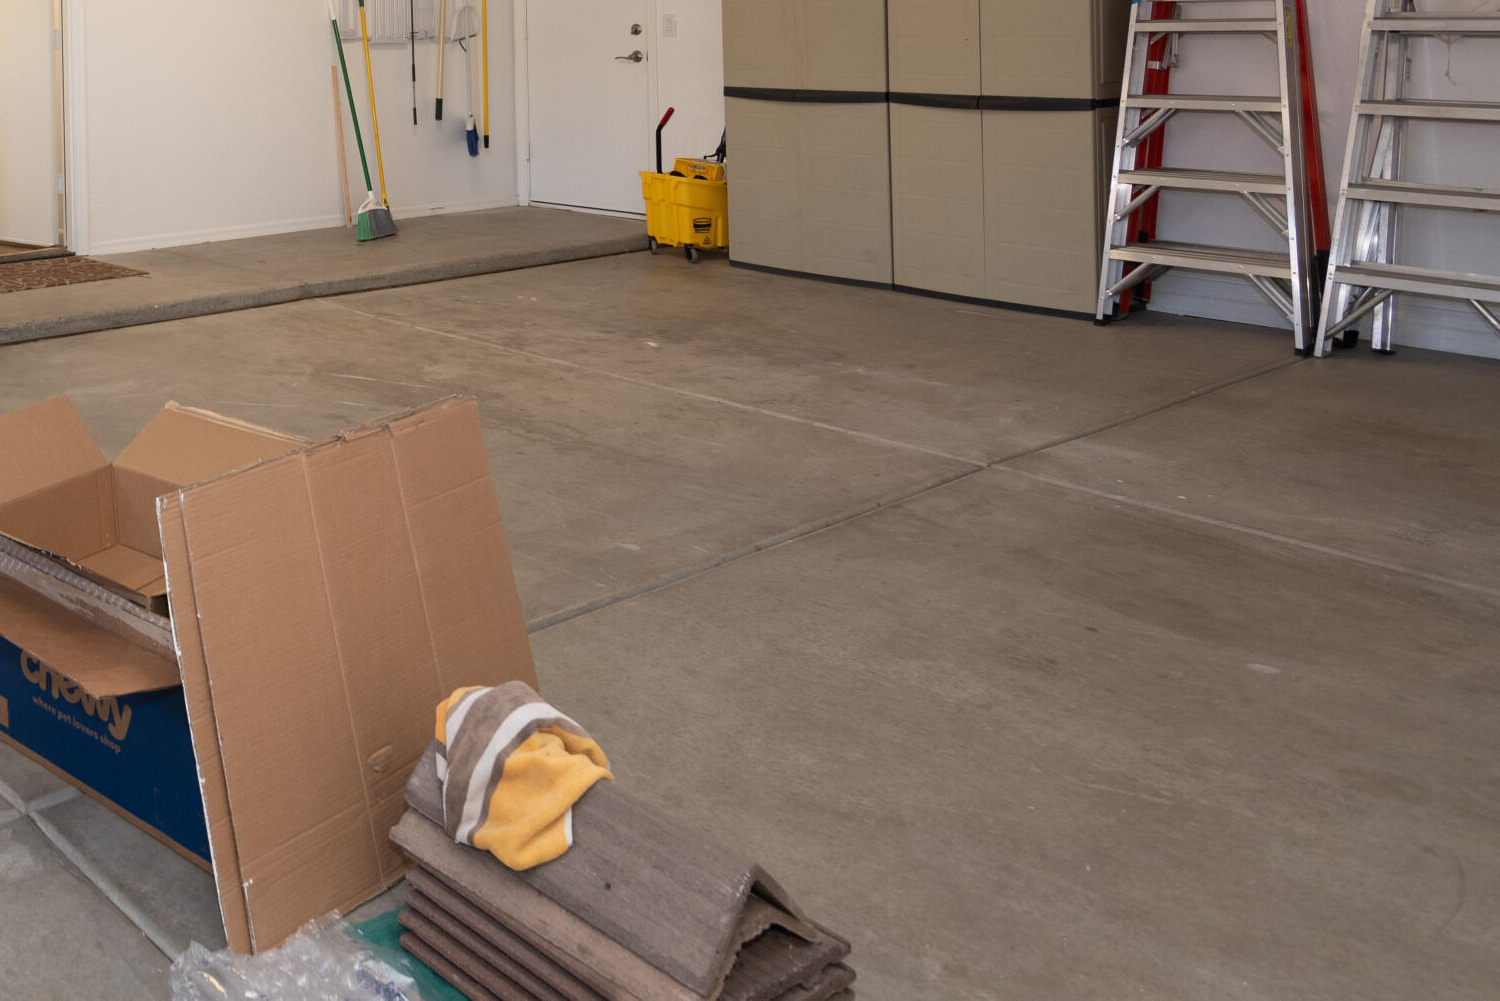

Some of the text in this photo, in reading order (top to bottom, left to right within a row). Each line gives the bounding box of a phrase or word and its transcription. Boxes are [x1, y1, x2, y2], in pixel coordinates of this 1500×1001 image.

[32, 695, 121, 755] where pet lovers shop
